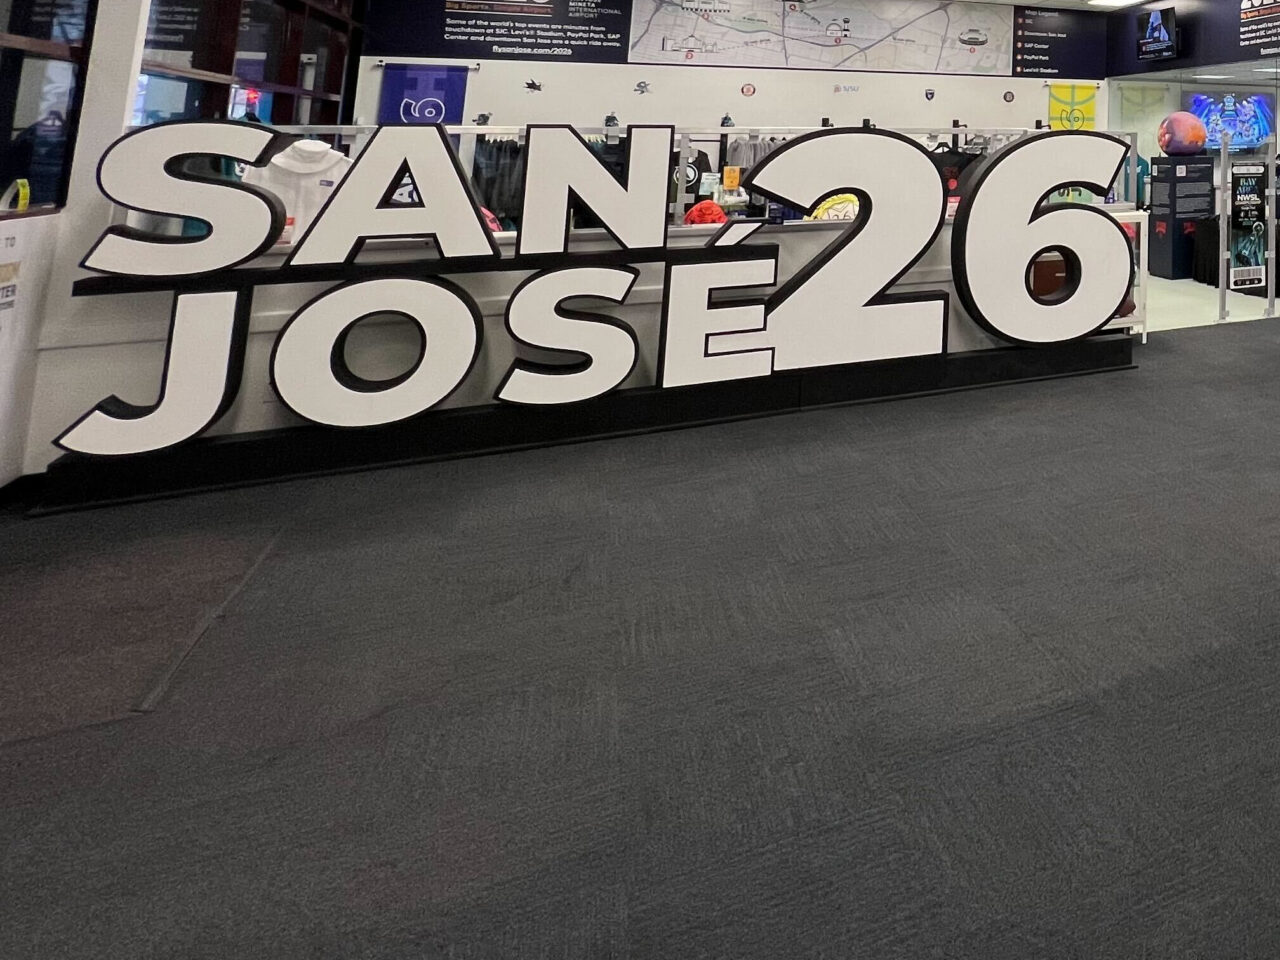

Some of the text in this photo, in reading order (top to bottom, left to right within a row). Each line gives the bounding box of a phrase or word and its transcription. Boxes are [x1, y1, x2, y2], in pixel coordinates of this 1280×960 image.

[568, 7, 622, 15] INTERNATIONAL
[82, 119, 677, 277] SAN
[1240, 178, 1257, 186] BAY
[55, 127, 1137, 458] JOSÉ 26
